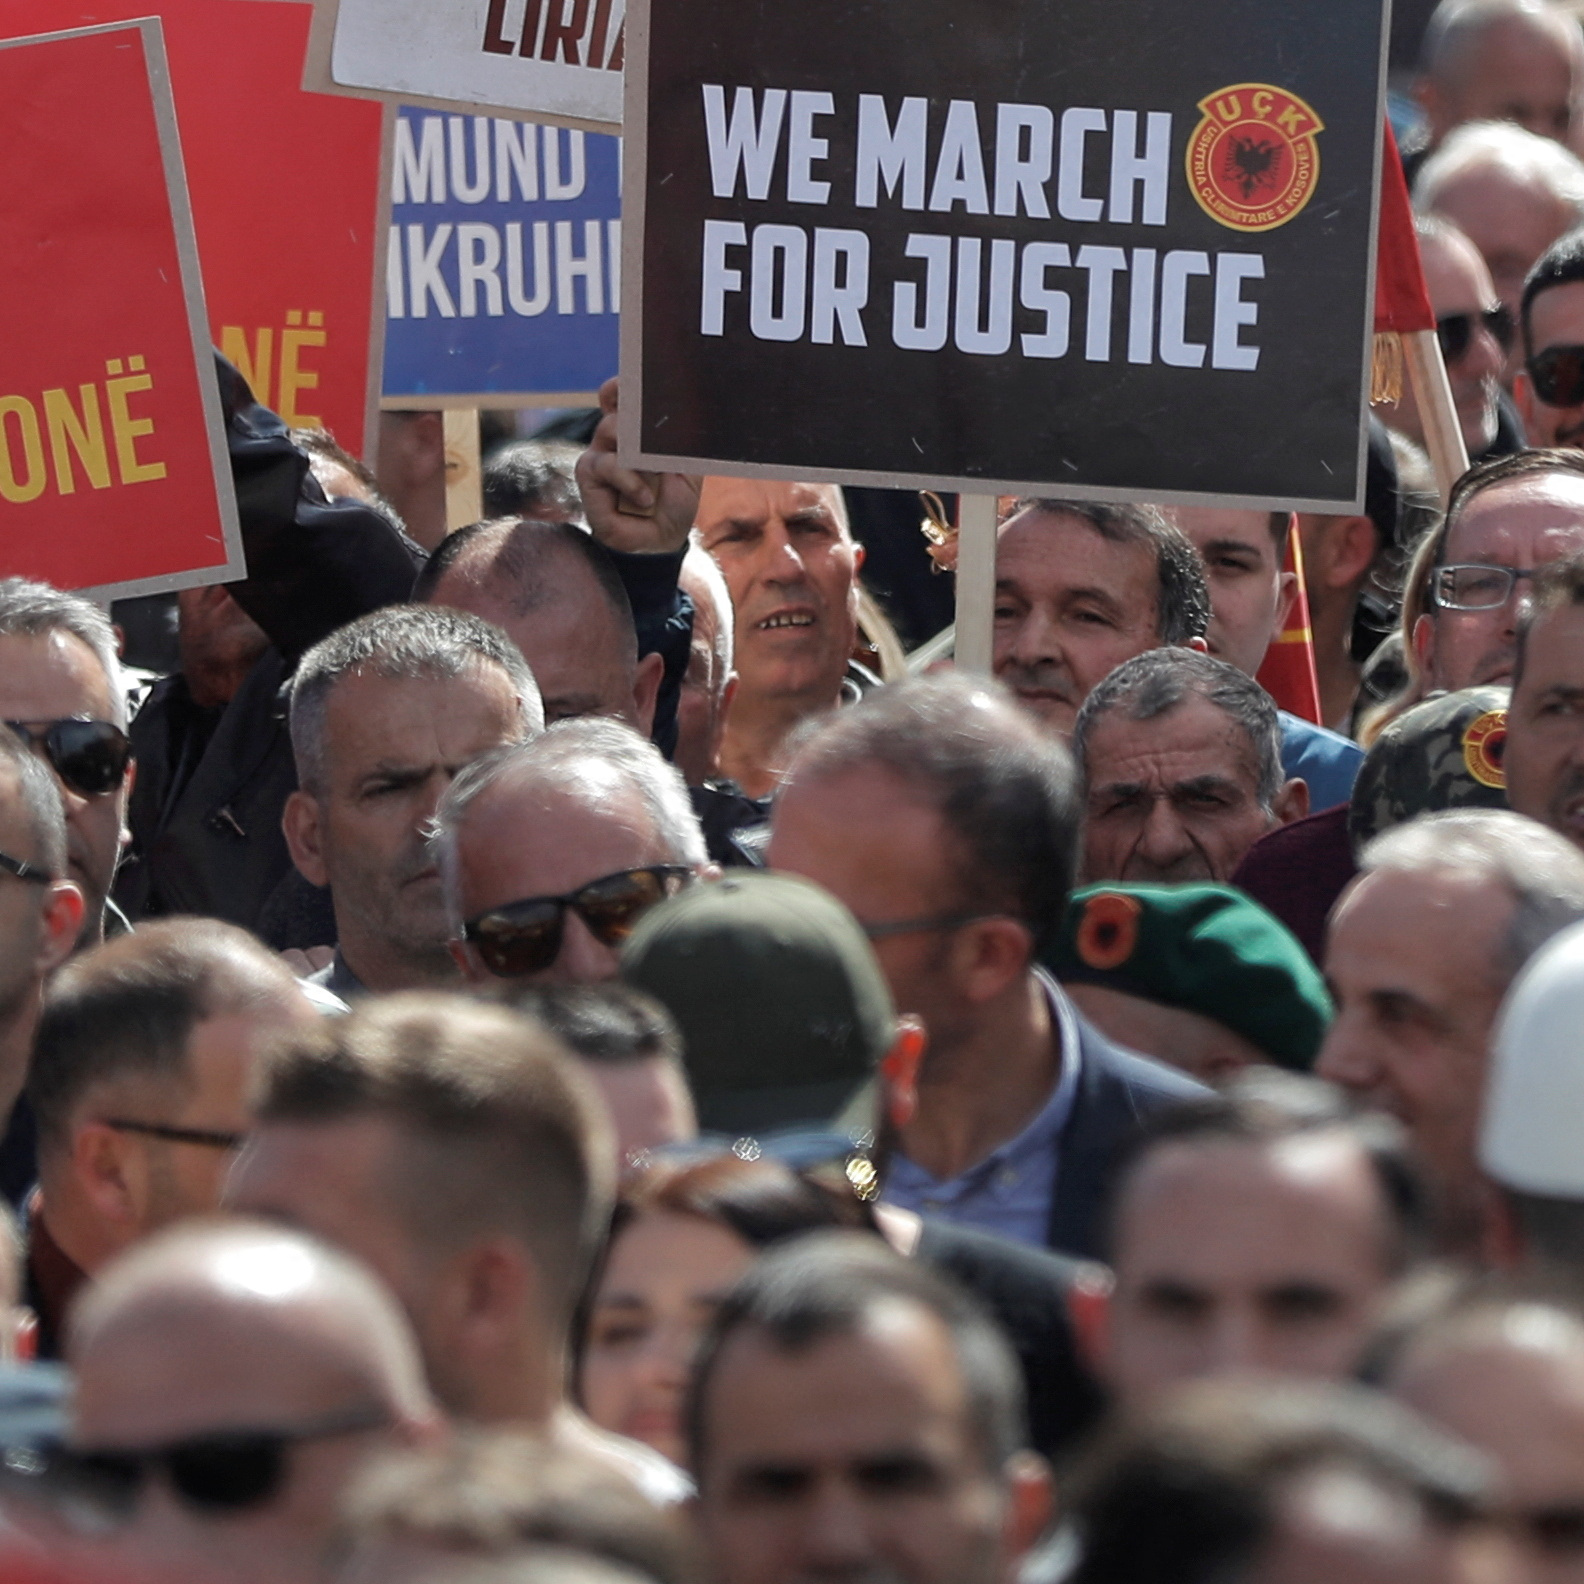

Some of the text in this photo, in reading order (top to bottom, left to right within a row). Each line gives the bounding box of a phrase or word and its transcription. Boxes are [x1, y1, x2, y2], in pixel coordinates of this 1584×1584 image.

[700, 83, 1173, 226] WE MARCH
[1216, 91, 1308, 135] UÇK
[700, 219, 1266, 372] FOR JUSTICE
[220, 309, 328, 430] NË
